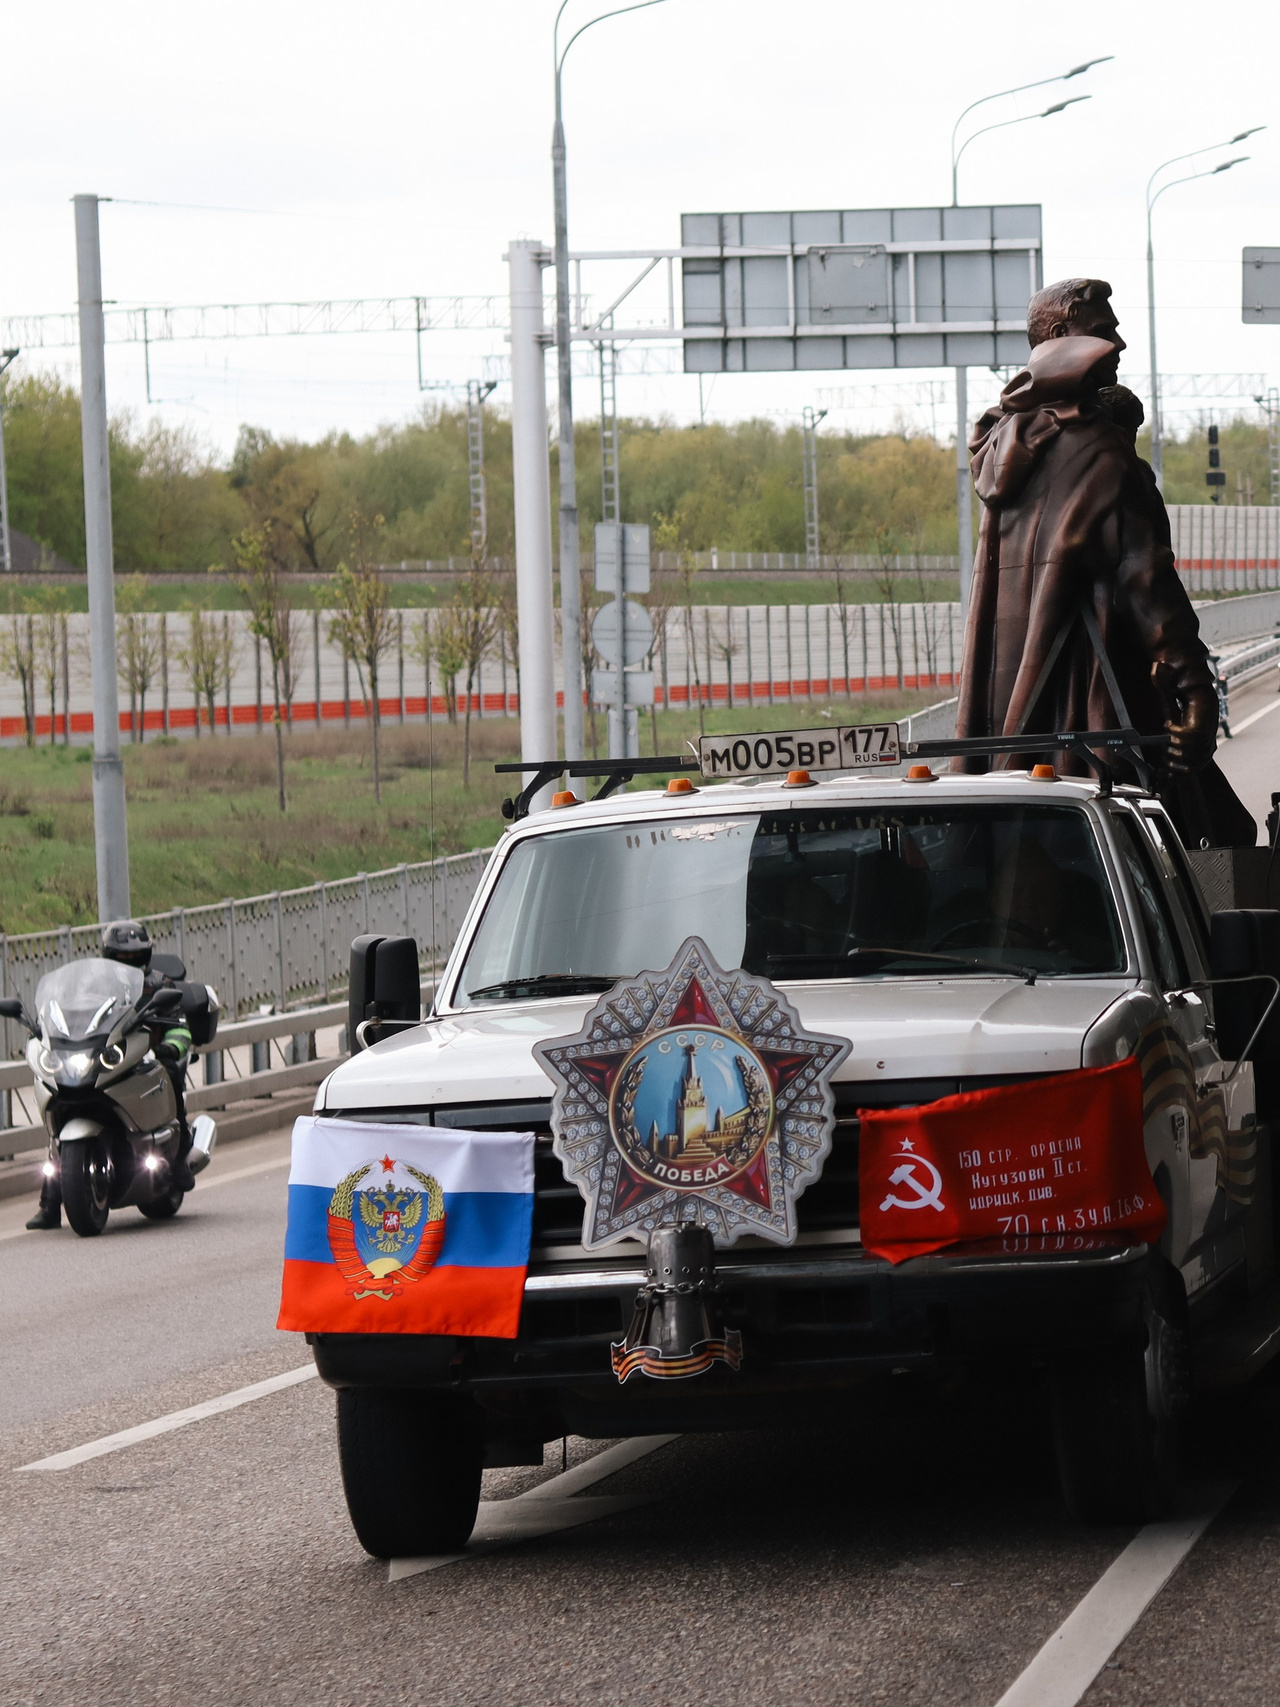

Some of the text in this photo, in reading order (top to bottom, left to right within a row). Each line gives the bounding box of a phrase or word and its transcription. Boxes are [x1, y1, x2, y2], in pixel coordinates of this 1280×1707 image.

[844, 727, 890, 754] 177
[855, 753, 878, 763] RUS
[658, 1034, 725, 1054] СССР
[959, 1149, 982, 1169] 150
[1030, 1136, 1081, 1157] ОРДЕНА
[653, 1162, 730, 1182] ПОБЕДА
[997, 1214, 1030, 1235] 70
